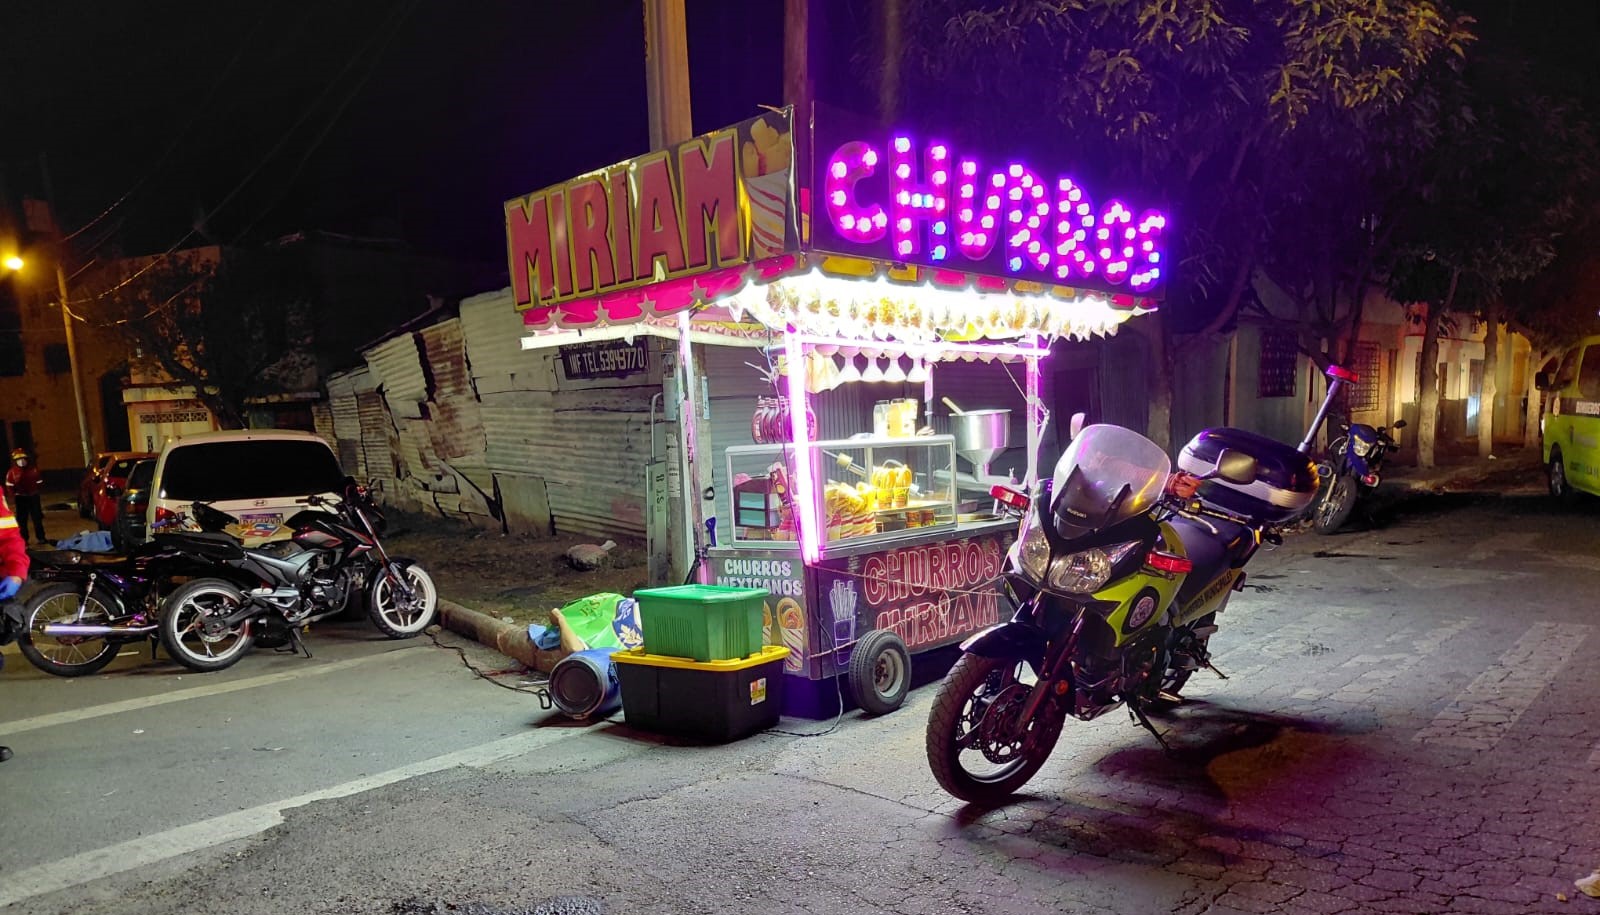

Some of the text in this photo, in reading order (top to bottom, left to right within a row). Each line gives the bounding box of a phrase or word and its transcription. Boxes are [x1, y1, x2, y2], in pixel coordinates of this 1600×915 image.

[505, 128, 742, 312] MIRIAM
[826, 137, 1167, 291] CHURROS
[717, 576, 803, 596] MEXICANOS
[724, 559, 791, 577] CHURROS
[864, 540, 1000, 605] CHURROS
[876, 588, 999, 647] MIRIAM
